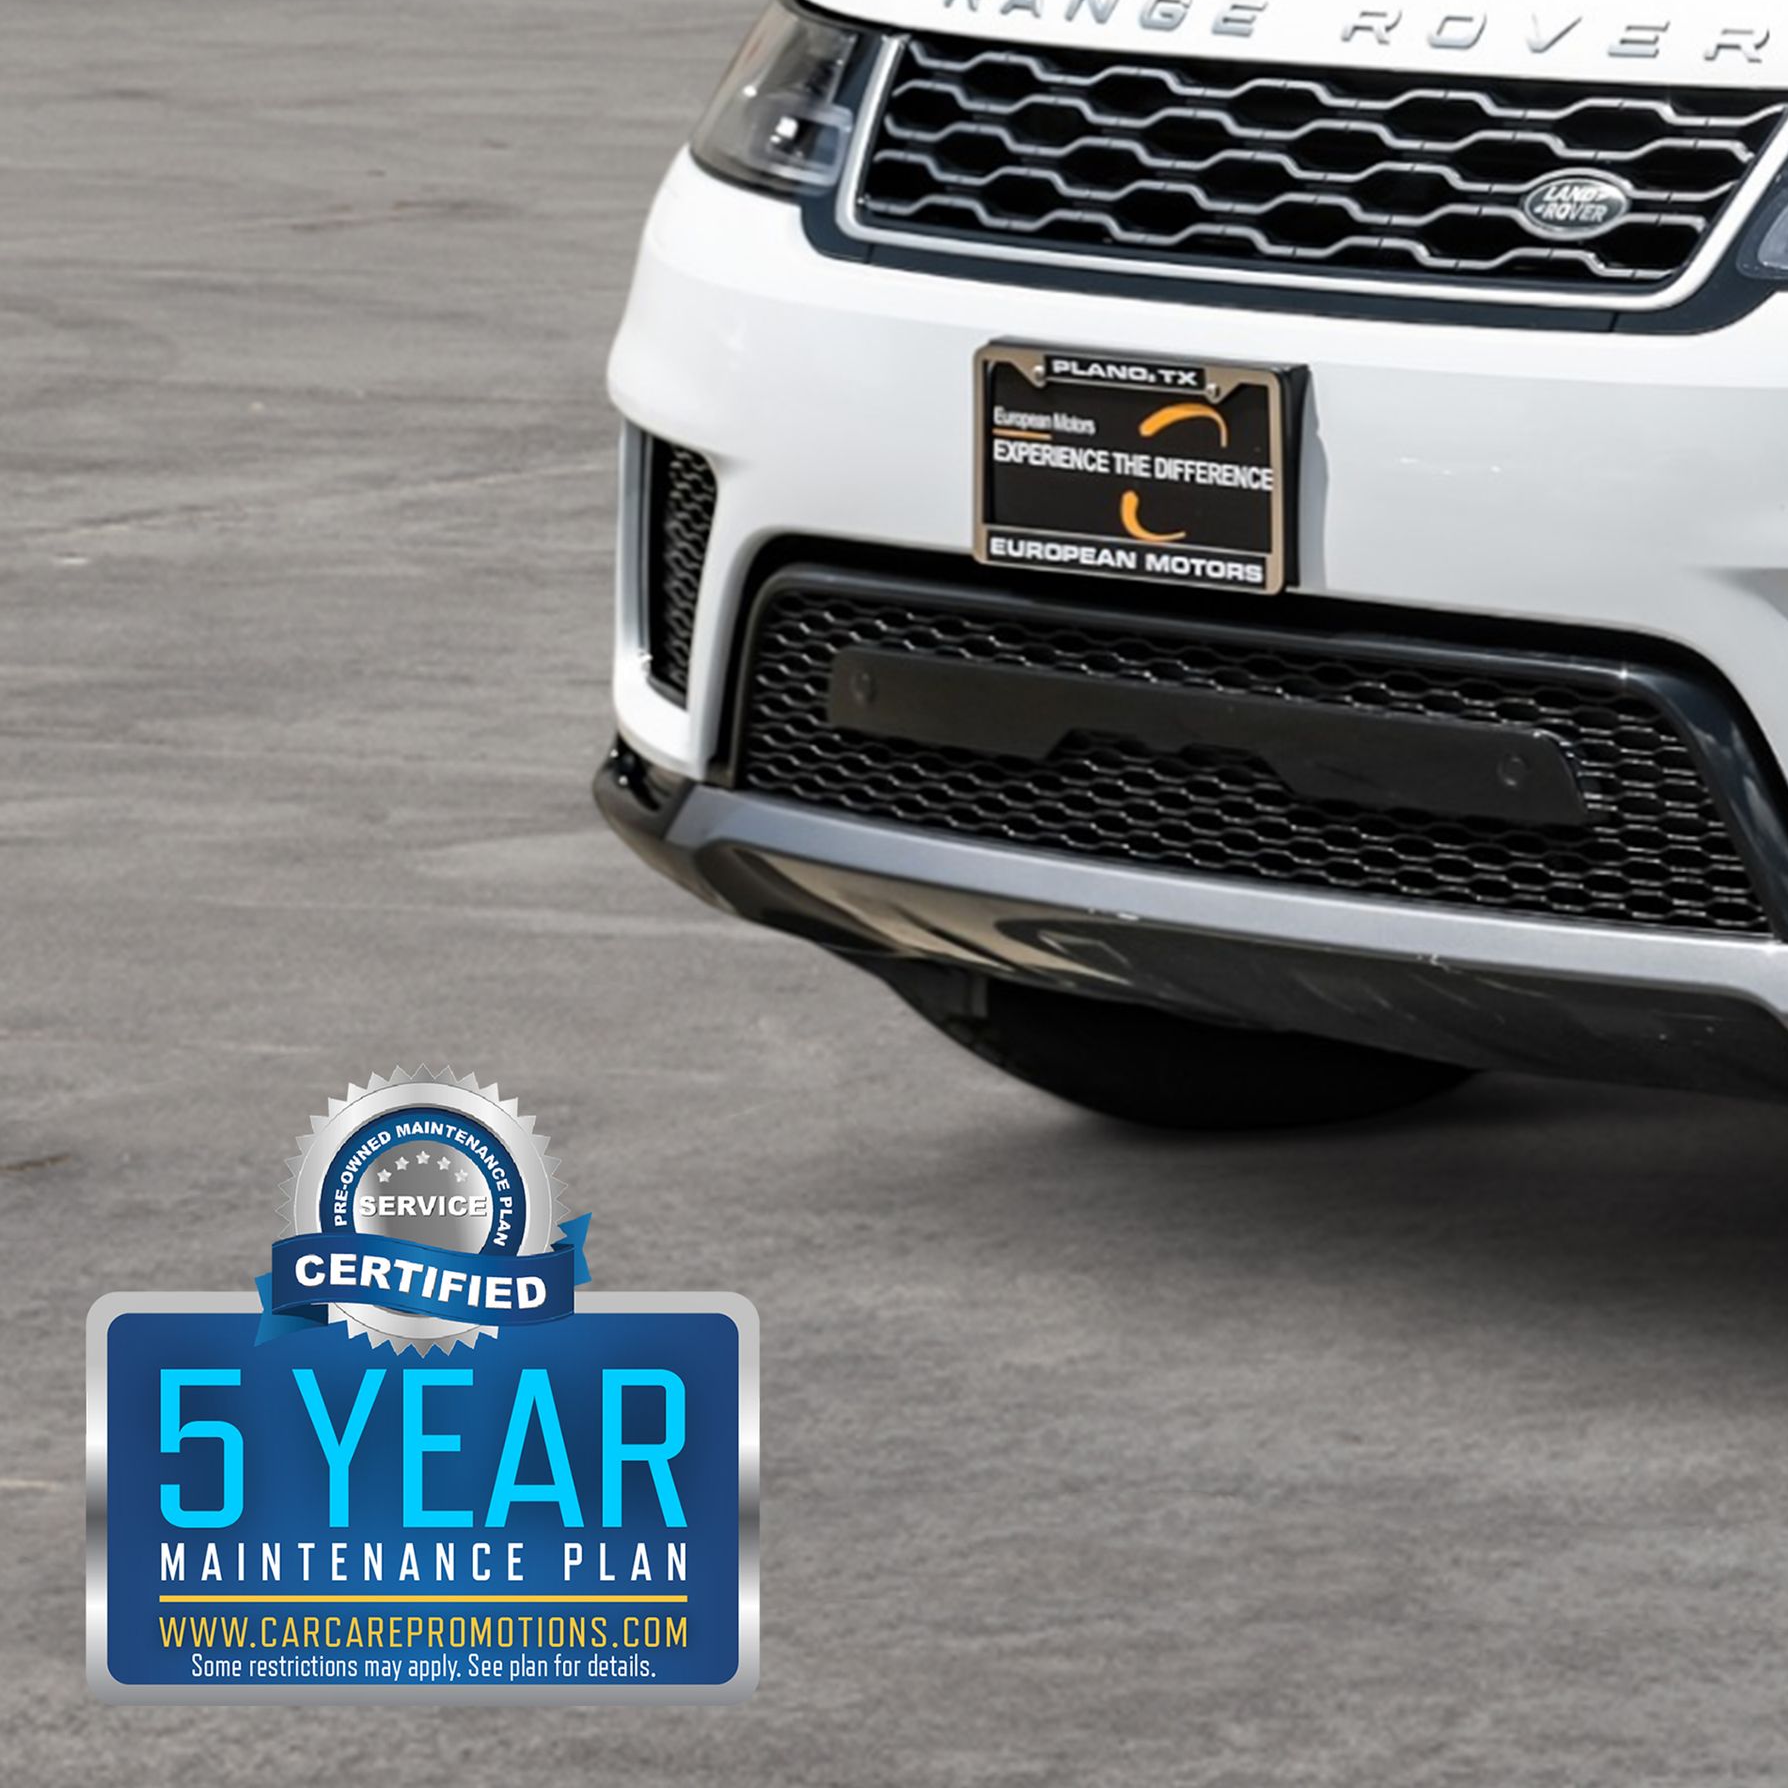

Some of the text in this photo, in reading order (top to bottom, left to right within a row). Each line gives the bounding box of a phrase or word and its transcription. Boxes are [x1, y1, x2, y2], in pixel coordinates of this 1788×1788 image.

[1340, 9, 1770, 64] ROVER
[1543, 184, 1600, 202] LAND
[1541, 203, 1608, 222] ROVER
[1157, 369, 1198, 386] TX
[993, 406, 1096, 434] European Motors
[993, 439, 1273, 491] EXPERIENCE THE DIFFERENCE
[989, 536, 1264, 583] EUROPEAN MOTORS
